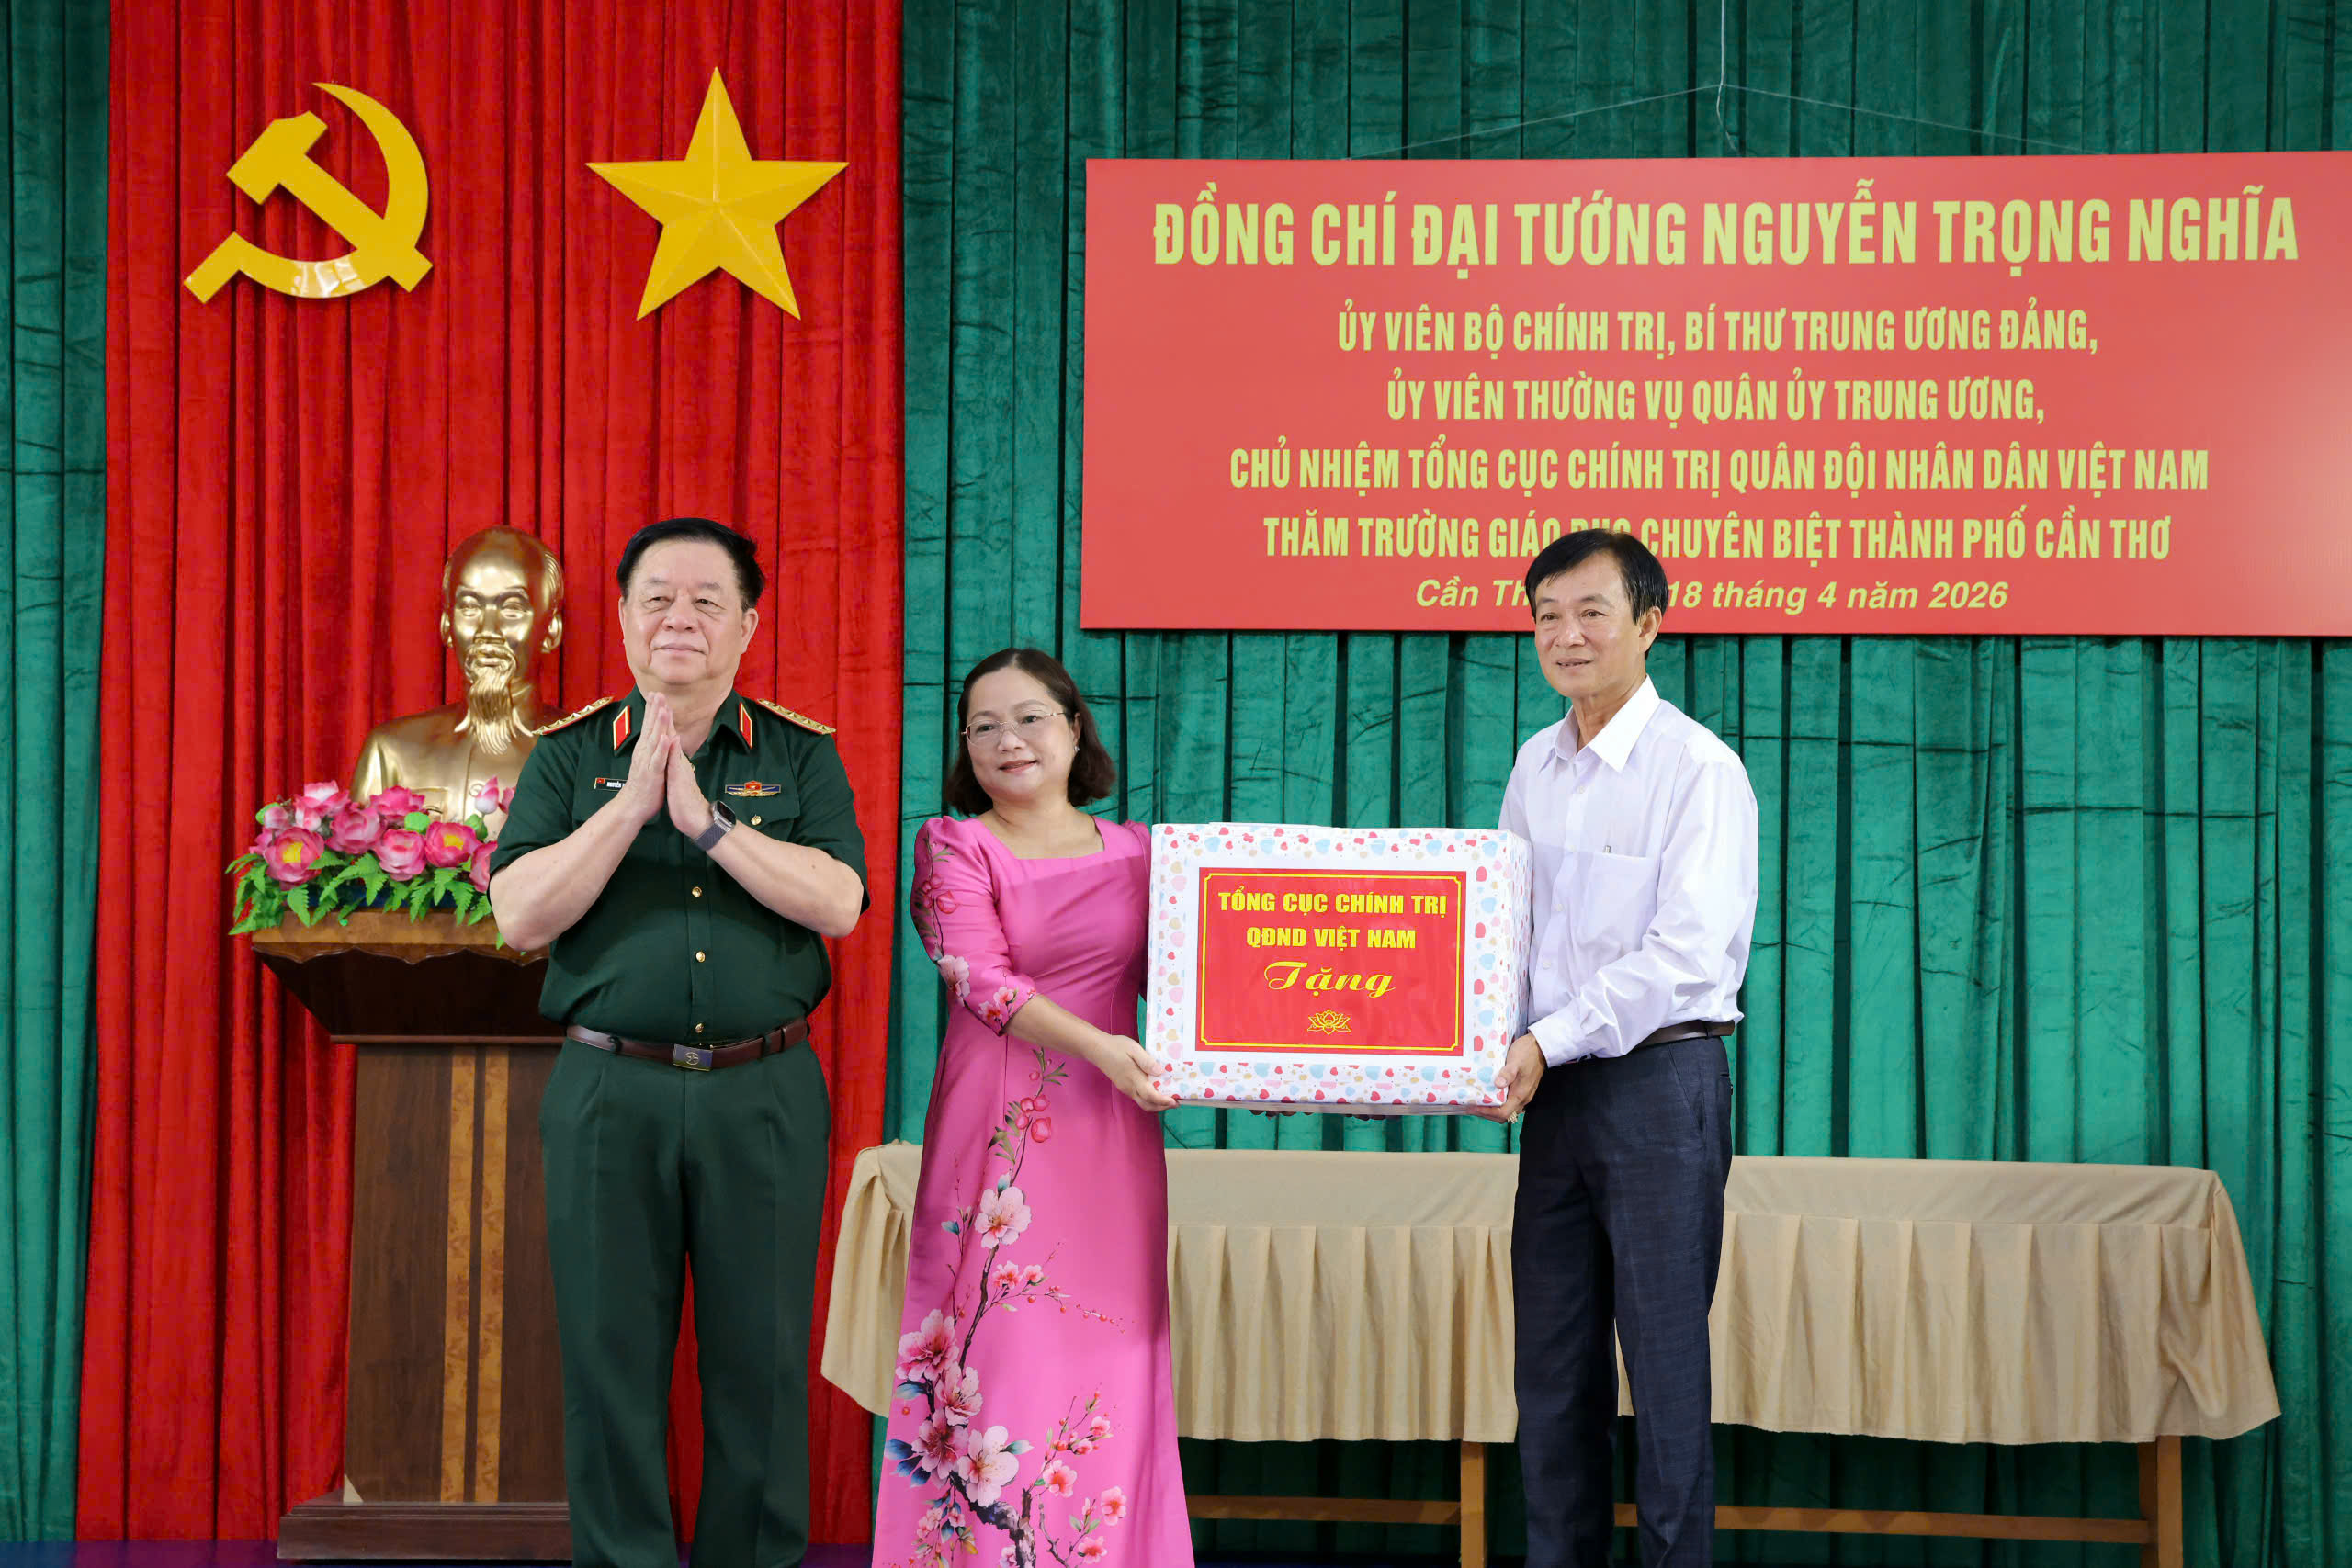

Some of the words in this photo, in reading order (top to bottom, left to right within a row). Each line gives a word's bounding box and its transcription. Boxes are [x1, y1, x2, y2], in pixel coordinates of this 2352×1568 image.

[1153, 181, 1295, 265] ĐỒNG
[1311, 190, 1397, 266] CHÍ
[1410, 203, 1498, 280] ĐẠI
[1513, 189, 1687, 265] TƯỚNG
[1702, 177, 1917, 265] NGUYỄN
[1932, 199, 2110, 277] TRỌNG
[2128, 185, 2299, 263] NGHĨA
[1338, 298, 1377, 352] ỦY
[1385, 303, 1455, 352] VIÊN
[1464, 303, 1504, 361] BỘ
[1513, 302, 1609, 352] CHÍNH
[1617, 310, 1676, 361] TRỊ,
[1684, 303, 1717, 352] BÍ
[1724, 308, 1787, 352] THƯ
[1791, 310, 1895, 352] TRUNG
[1905, 306, 1991, 351] ƯƠNG
[1998, 296, 2098, 355] ĐẢNG,
[1387, 367, 1426, 420] ỦY
[1433, 372, 1505, 420] VIÊN
[1512, 370, 1636, 421] THƯỜNG
[1645, 380, 1684, 430] VỤ
[1692, 372, 1778, 425] QUÂN
[1786, 367, 1826, 421] ỦY
[1834, 379, 1939, 420] TRUNG
[1947, 375, 2044, 424] ƯƠNG,
[1230, 434, 1291, 489] CHỦ
[1299, 440, 1400, 497] NHIỆM
[1408, 433, 1489, 490] TỔNG
[1498, 448, 1559, 498] CỤC
[1567, 440, 1664, 490] CHÍNH
[1671, 449, 1721, 499] TRỊ
[1729, 441, 1815, 494] QUÂN
[1823, 441, 1877, 499] ĐỘI
[1885, 440, 1974, 490] NHÂN
[1984, 440, 2049, 490] DÂN
[2057, 440, 2127, 499] VIỆT
[2134, 449, 2209, 490] NAM
[1263, 508, 1349, 557] THĂM
[1357, 508, 1480, 558] TRƯỜNG
[1488, 509, 1561, 558] GIÁO
[1640, 510, 1765, 559] CHUYÊN
[1772, 510, 1842, 568] BIỆT
[1849, 510, 1954, 559] THÀNH
[1962, 504, 2028, 559] PHỐ
[2035, 504, 2101, 559] CẦN
[2109, 515, 2172, 560] THƠ
[1416, 575, 1479, 607] Cần
[1492, 580, 1530, 607] Th
[1668, 581, 1703, 609] 18
[1713, 580, 1808, 616] tháng
[1817, 581, 1838, 608] 4
[1847, 581, 1919, 609] năm
[1928, 581, 2009, 609] 2026
[1217, 886, 1276, 912] TỔNG
[1283, 892, 1329, 917] CỤC
[1335, 891, 1405, 914] CHÍNH
[1410, 894, 1447, 918] TRỊ
[1246, 926, 1307, 949] QĐND
[1313, 925, 1361, 952] VIỆT
[1367, 929, 1417, 949] NAM
[1263, 961, 1396, 998] Tặng
